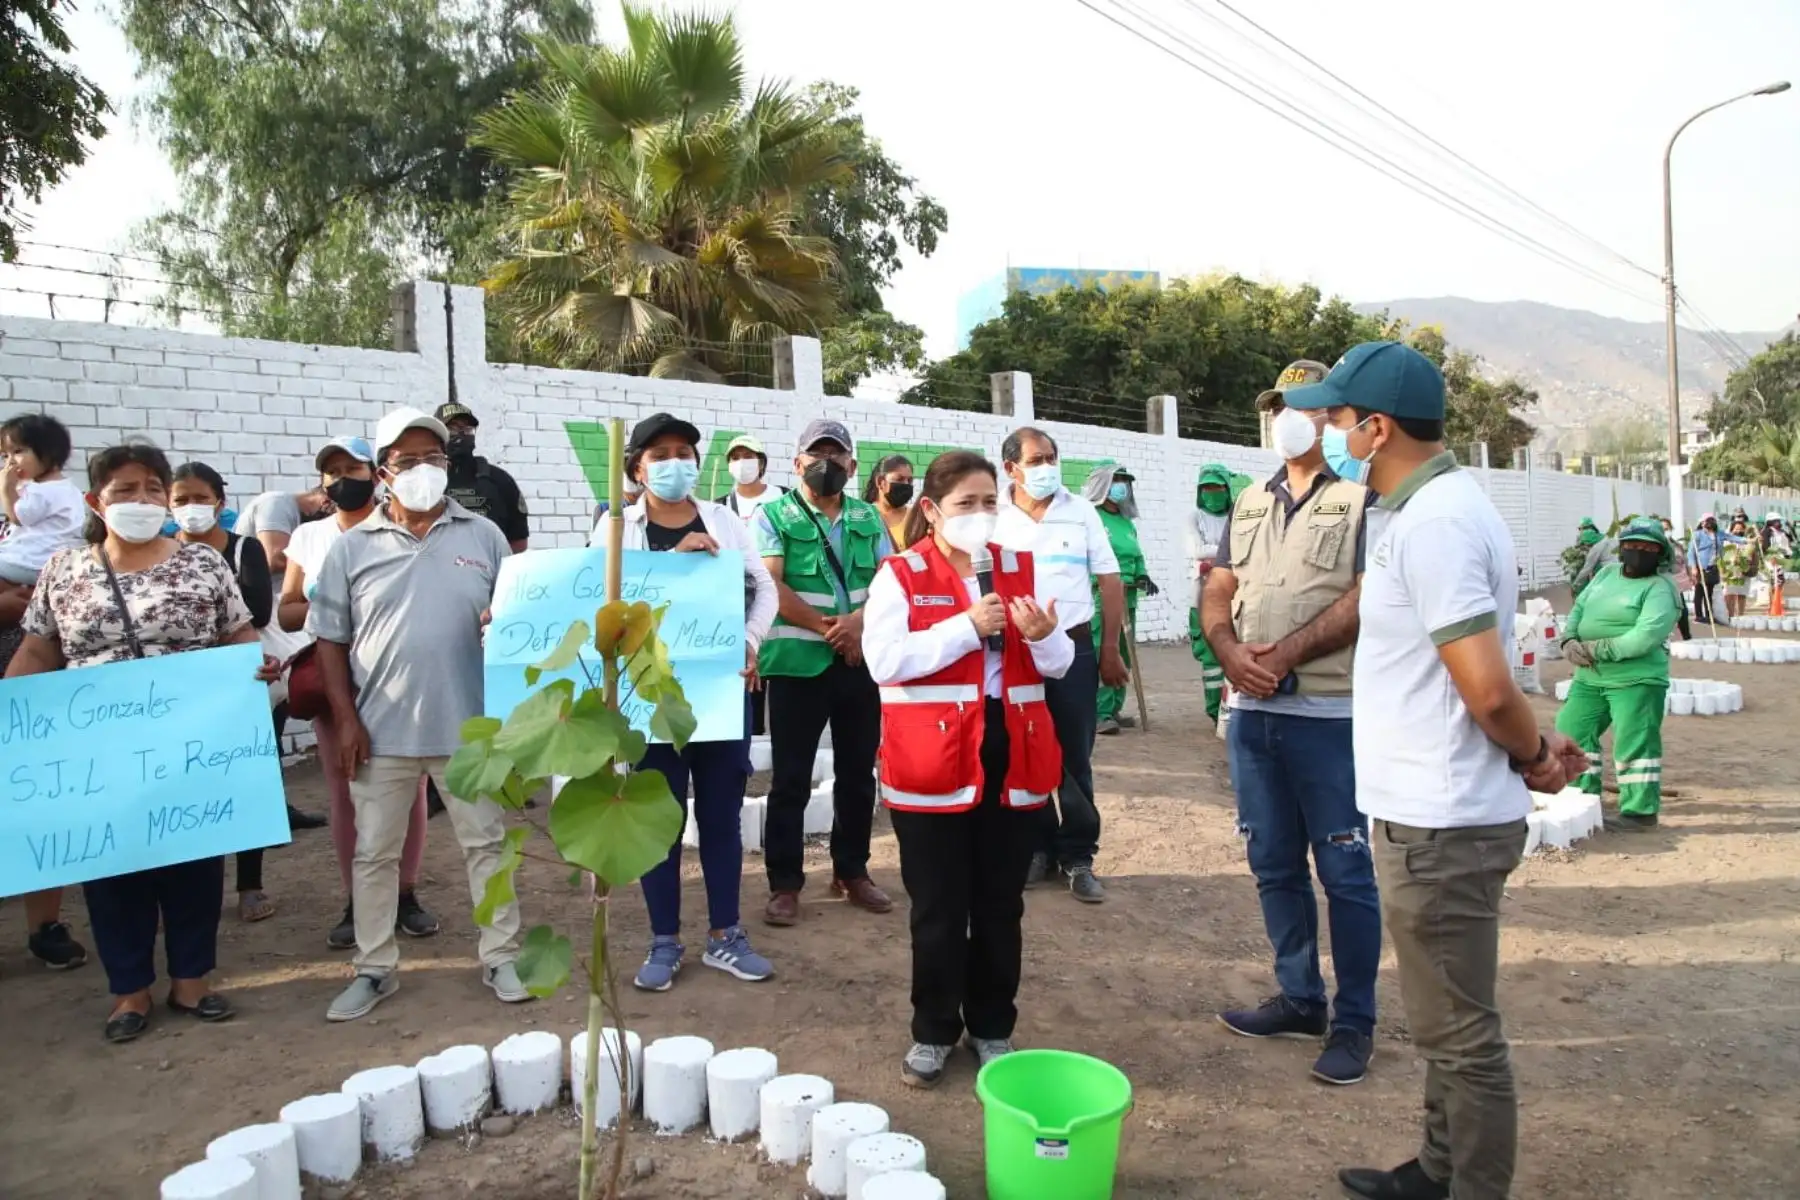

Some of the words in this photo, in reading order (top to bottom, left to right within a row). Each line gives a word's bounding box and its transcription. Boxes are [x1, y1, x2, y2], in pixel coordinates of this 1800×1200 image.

[573, 566, 666, 601] Gozales
[1, 697, 58, 744] Alex
[67, 680, 181, 729] Gonzales
[132, 748, 168, 783] Te
[26, 821, 116, 872] VILLA
[148, 797, 235, 846] MOSHA
